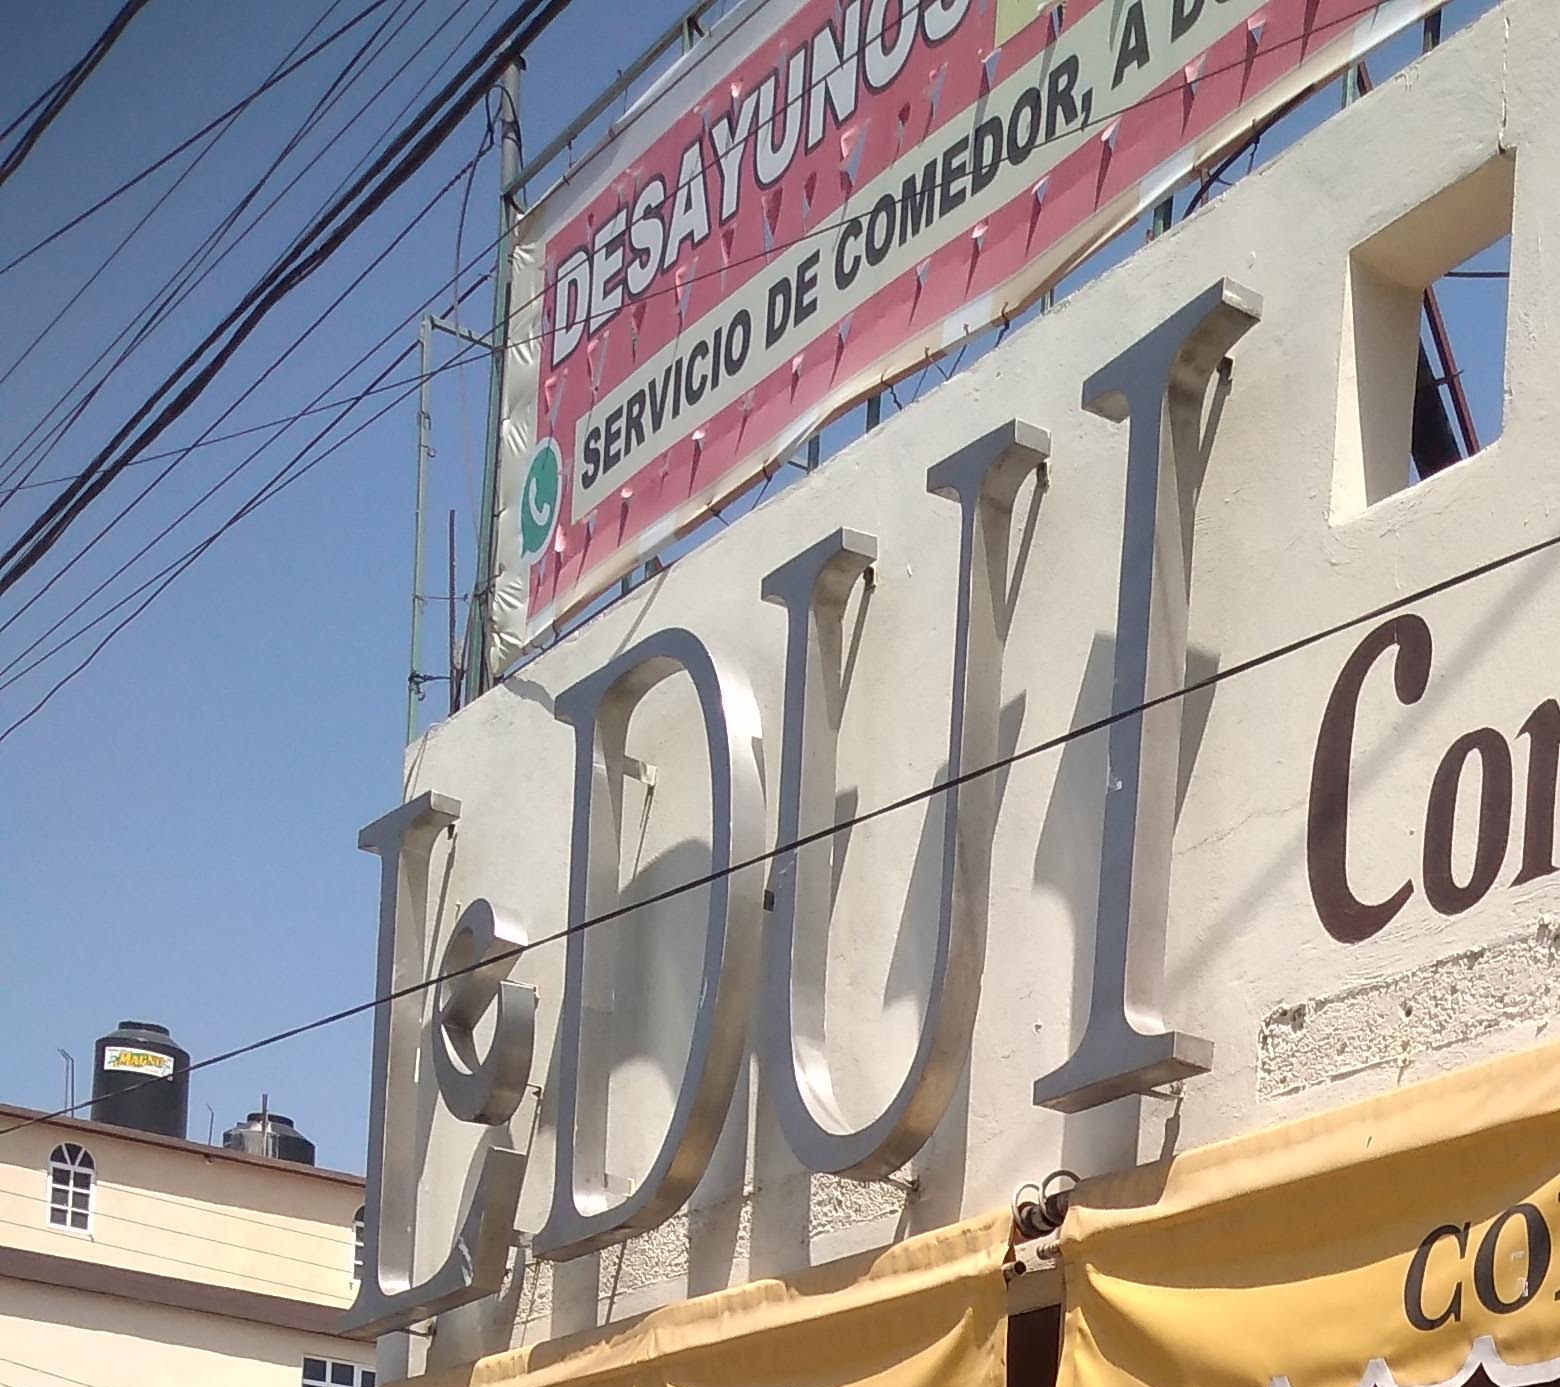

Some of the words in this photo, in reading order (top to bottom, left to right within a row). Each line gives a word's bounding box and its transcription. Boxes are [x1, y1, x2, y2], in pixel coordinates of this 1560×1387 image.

[580, 308, 752, 490] SERVICIO
[765, 248, 821, 350] DE
[833, 54, 1094, 291] COMEDOR,
[1111, 0, 1151, 91] A
[337, 275, 1263, 1342] LeDUI
